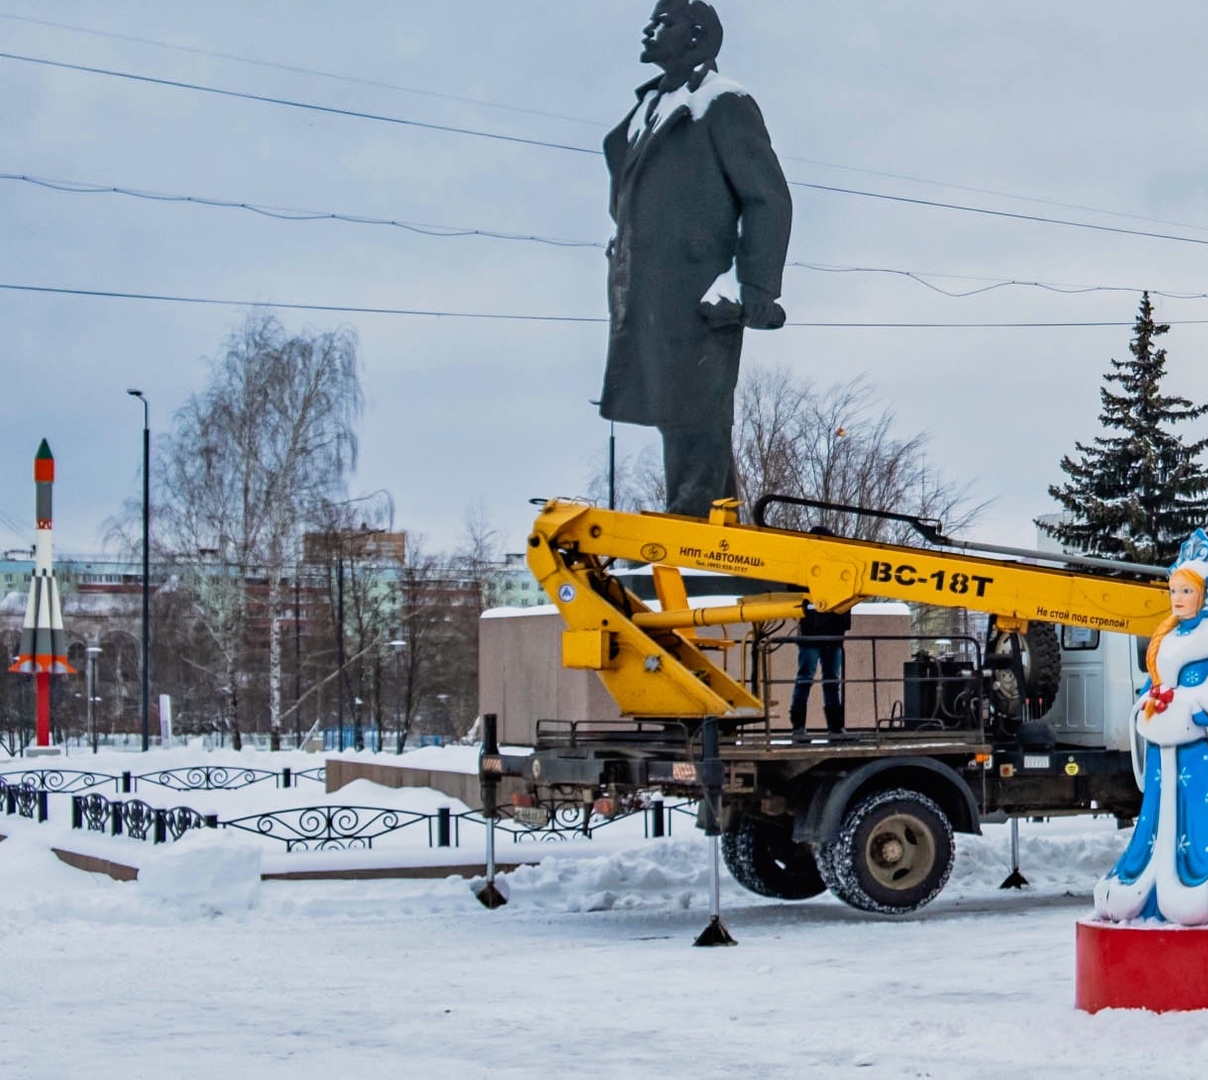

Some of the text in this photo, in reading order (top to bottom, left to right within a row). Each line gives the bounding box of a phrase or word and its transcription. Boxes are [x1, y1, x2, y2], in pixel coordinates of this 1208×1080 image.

[680, 546, 702, 558] НПП
[1036, 606, 1130, 629] Не стой под стрелой!
